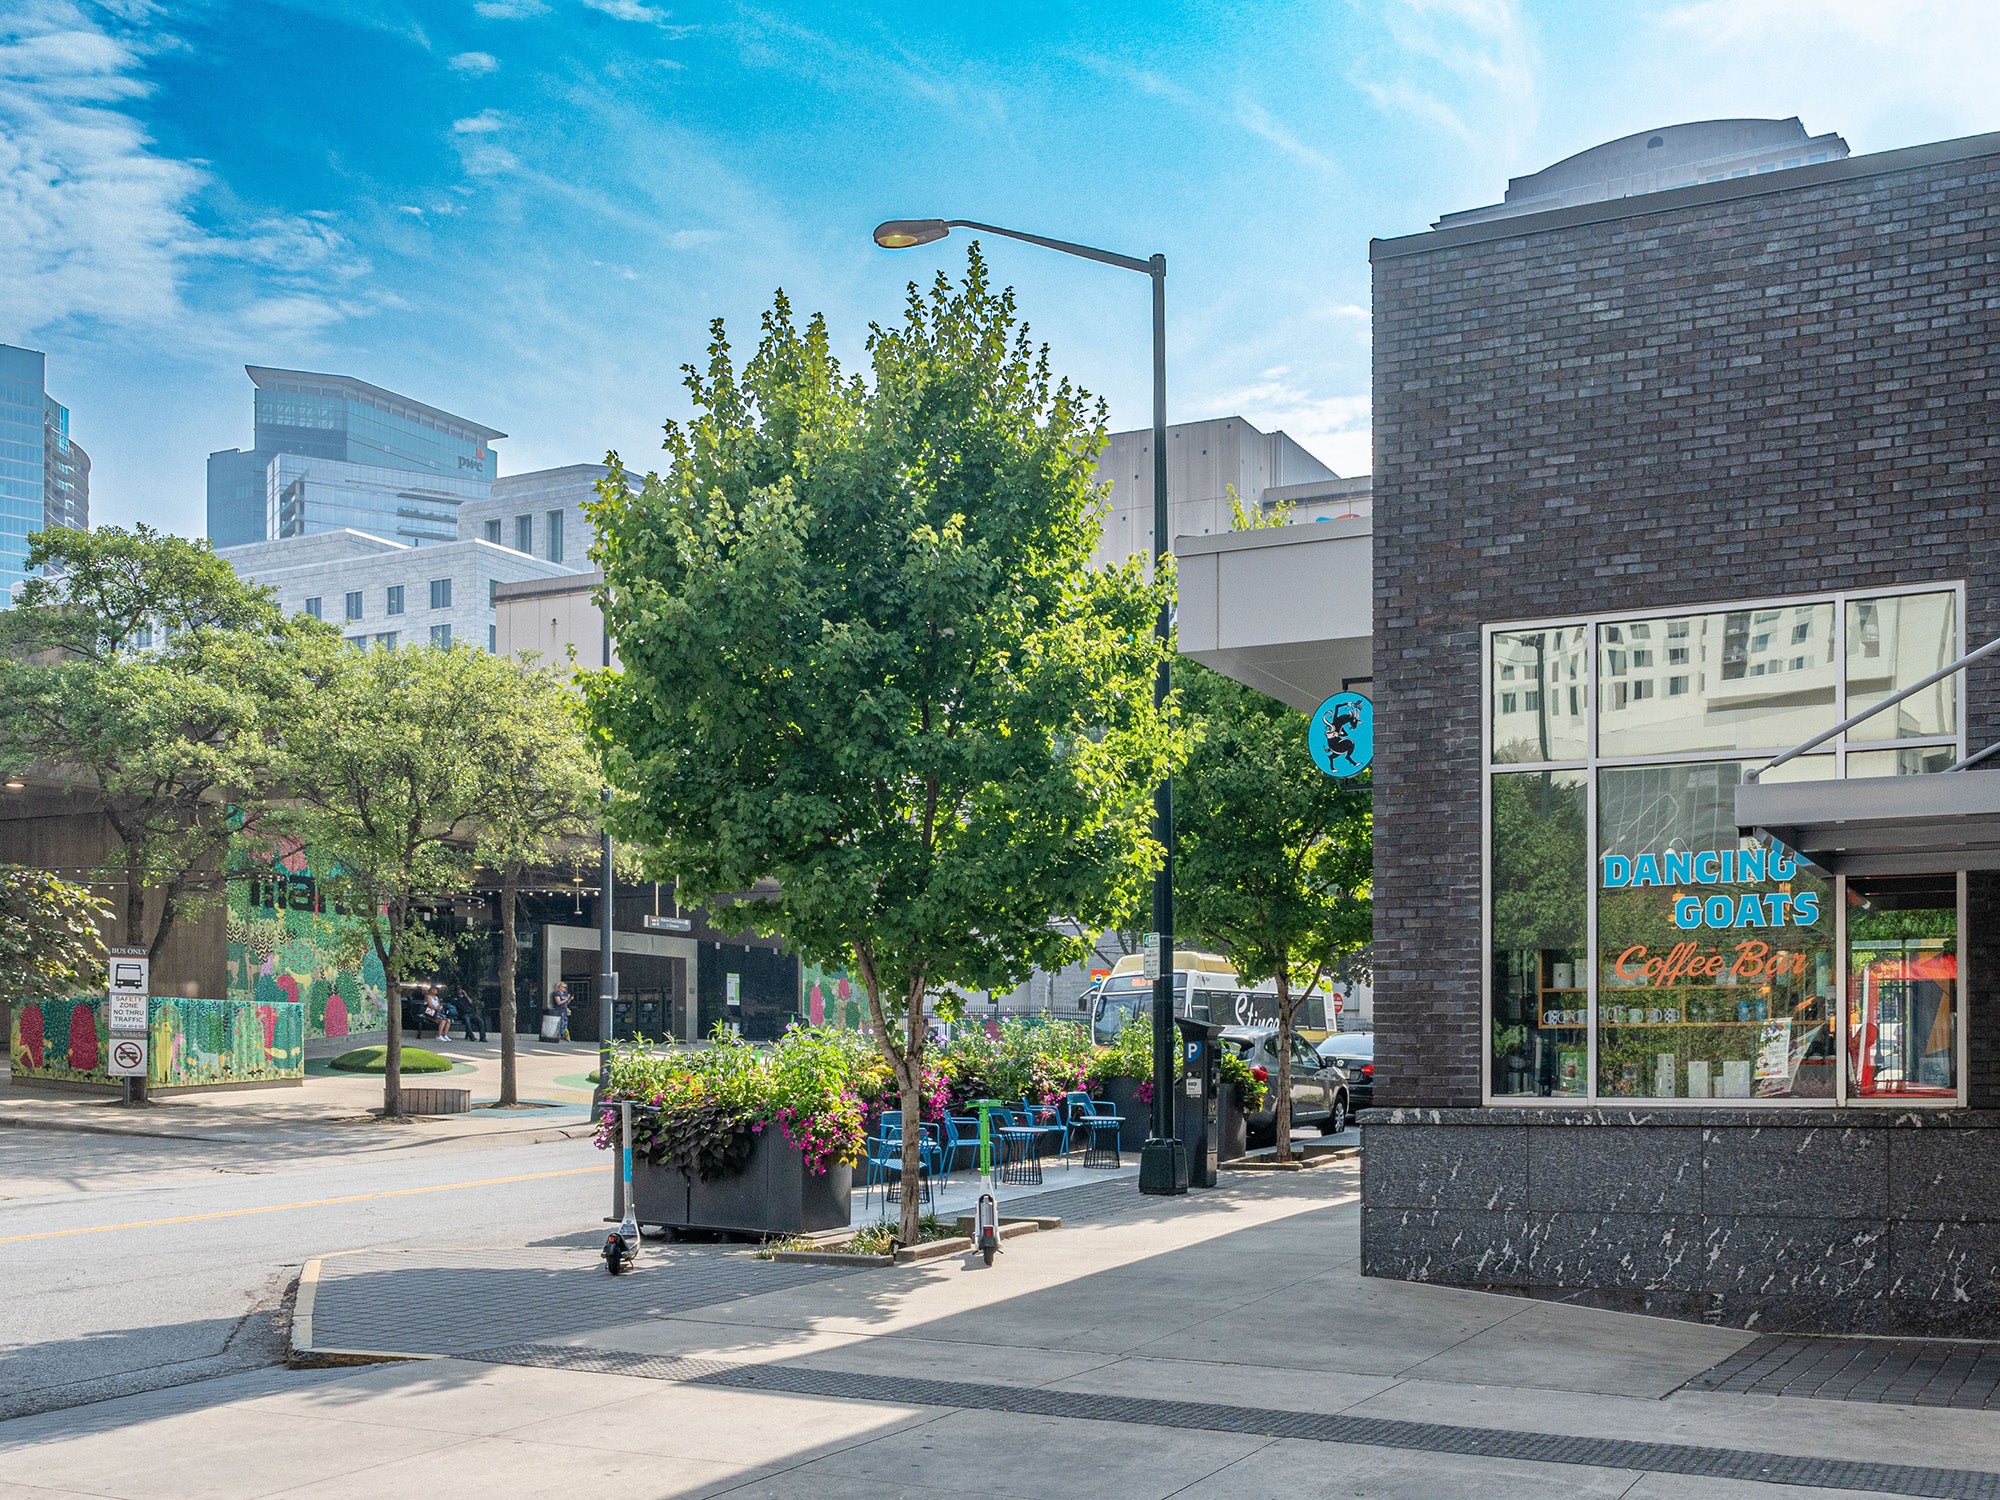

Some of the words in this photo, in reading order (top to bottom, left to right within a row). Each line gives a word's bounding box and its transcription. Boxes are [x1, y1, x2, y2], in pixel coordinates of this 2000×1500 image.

[457, 455, 483, 472] pwc
[1603, 848, 1797, 888] DANCING
[1674, 891, 1820, 930] GOATS
[111, 947, 126, 955] BUS
[127, 948, 147, 956] ONLY
[1615, 940, 1726, 988] Coffee
[1730, 938, 1809, 980] Bar
[1188, 1042, 1198, 1059] P
